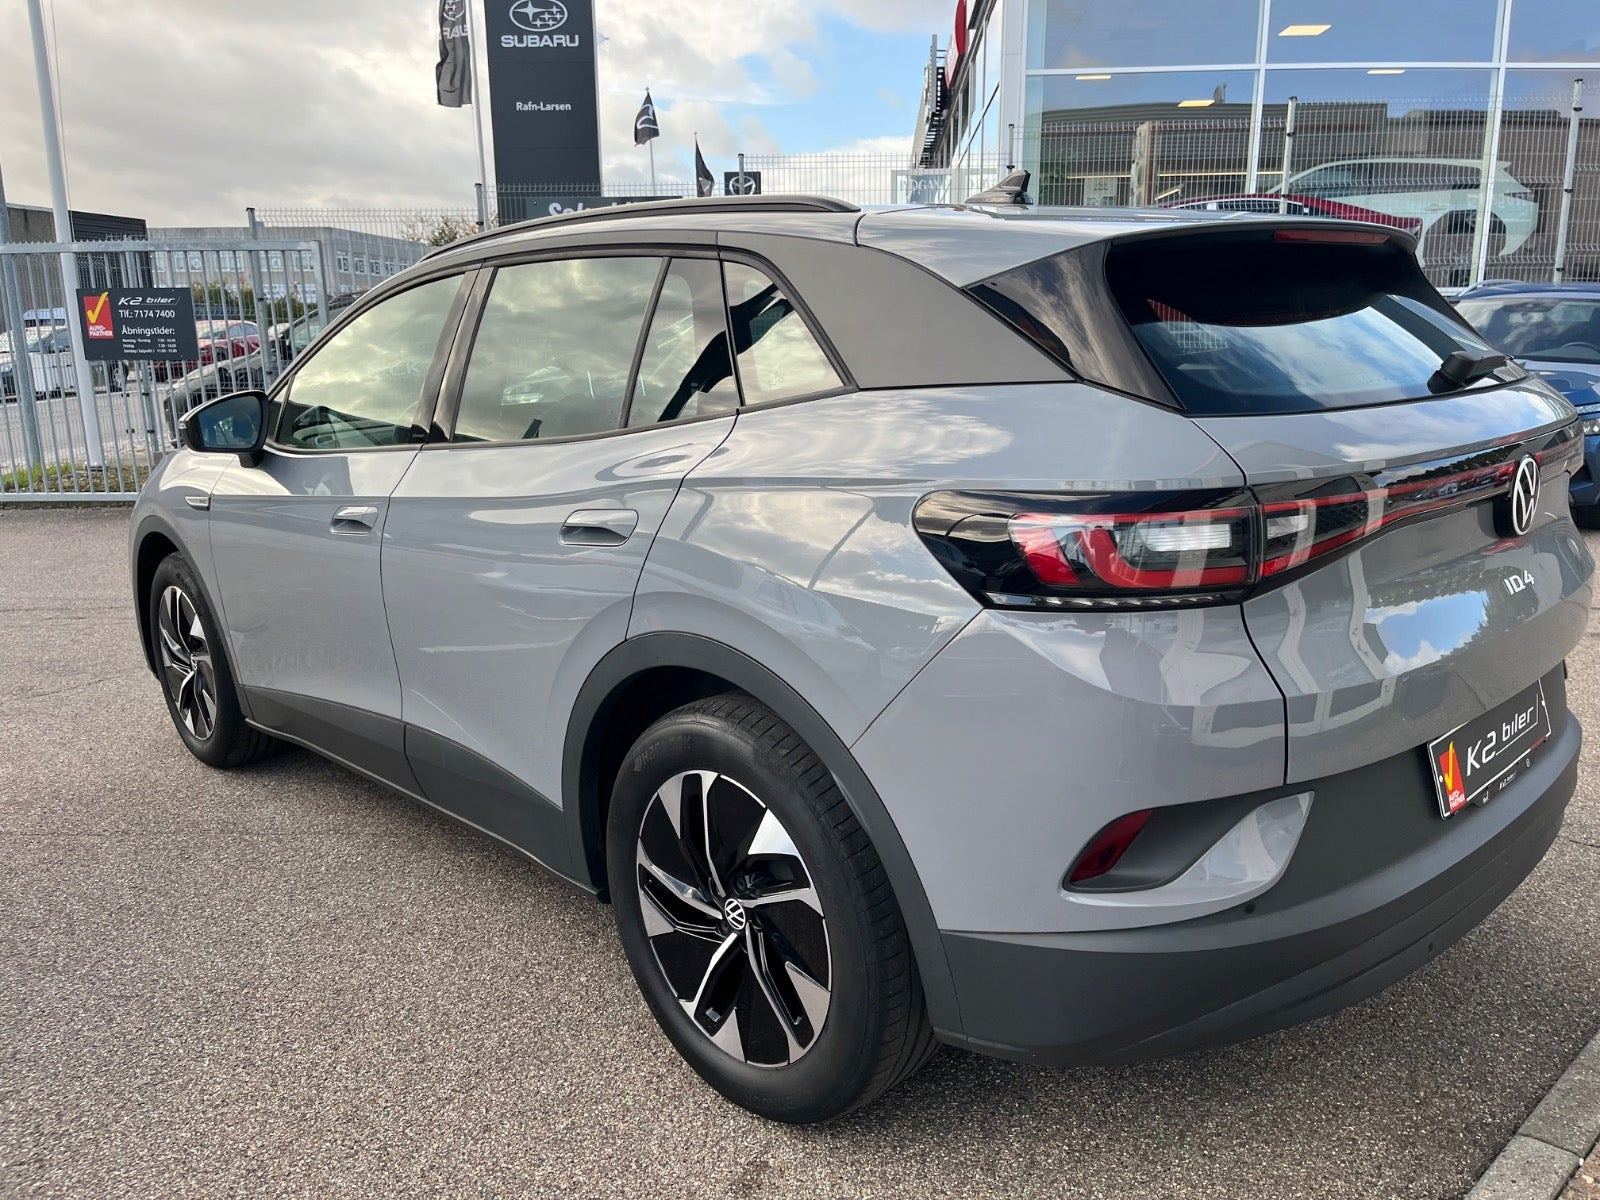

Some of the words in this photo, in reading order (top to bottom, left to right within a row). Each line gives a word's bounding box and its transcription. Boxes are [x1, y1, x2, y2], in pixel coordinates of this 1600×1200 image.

[501, 35, 579, 48] SUBARU
[516, 102, 572, 112] Rafn-Larsen
[119, 297, 142, 305] K2
[146, 296, 175, 304] biler
[119, 310, 133, 318] Tlf.:
[134, 310, 154, 318] 7174
[155, 310, 175, 318] 7400
[122, 325, 175, 336] Åbningstider:
[1467, 731, 1497, 776] K2
[1502, 706, 1534, 742] biler
